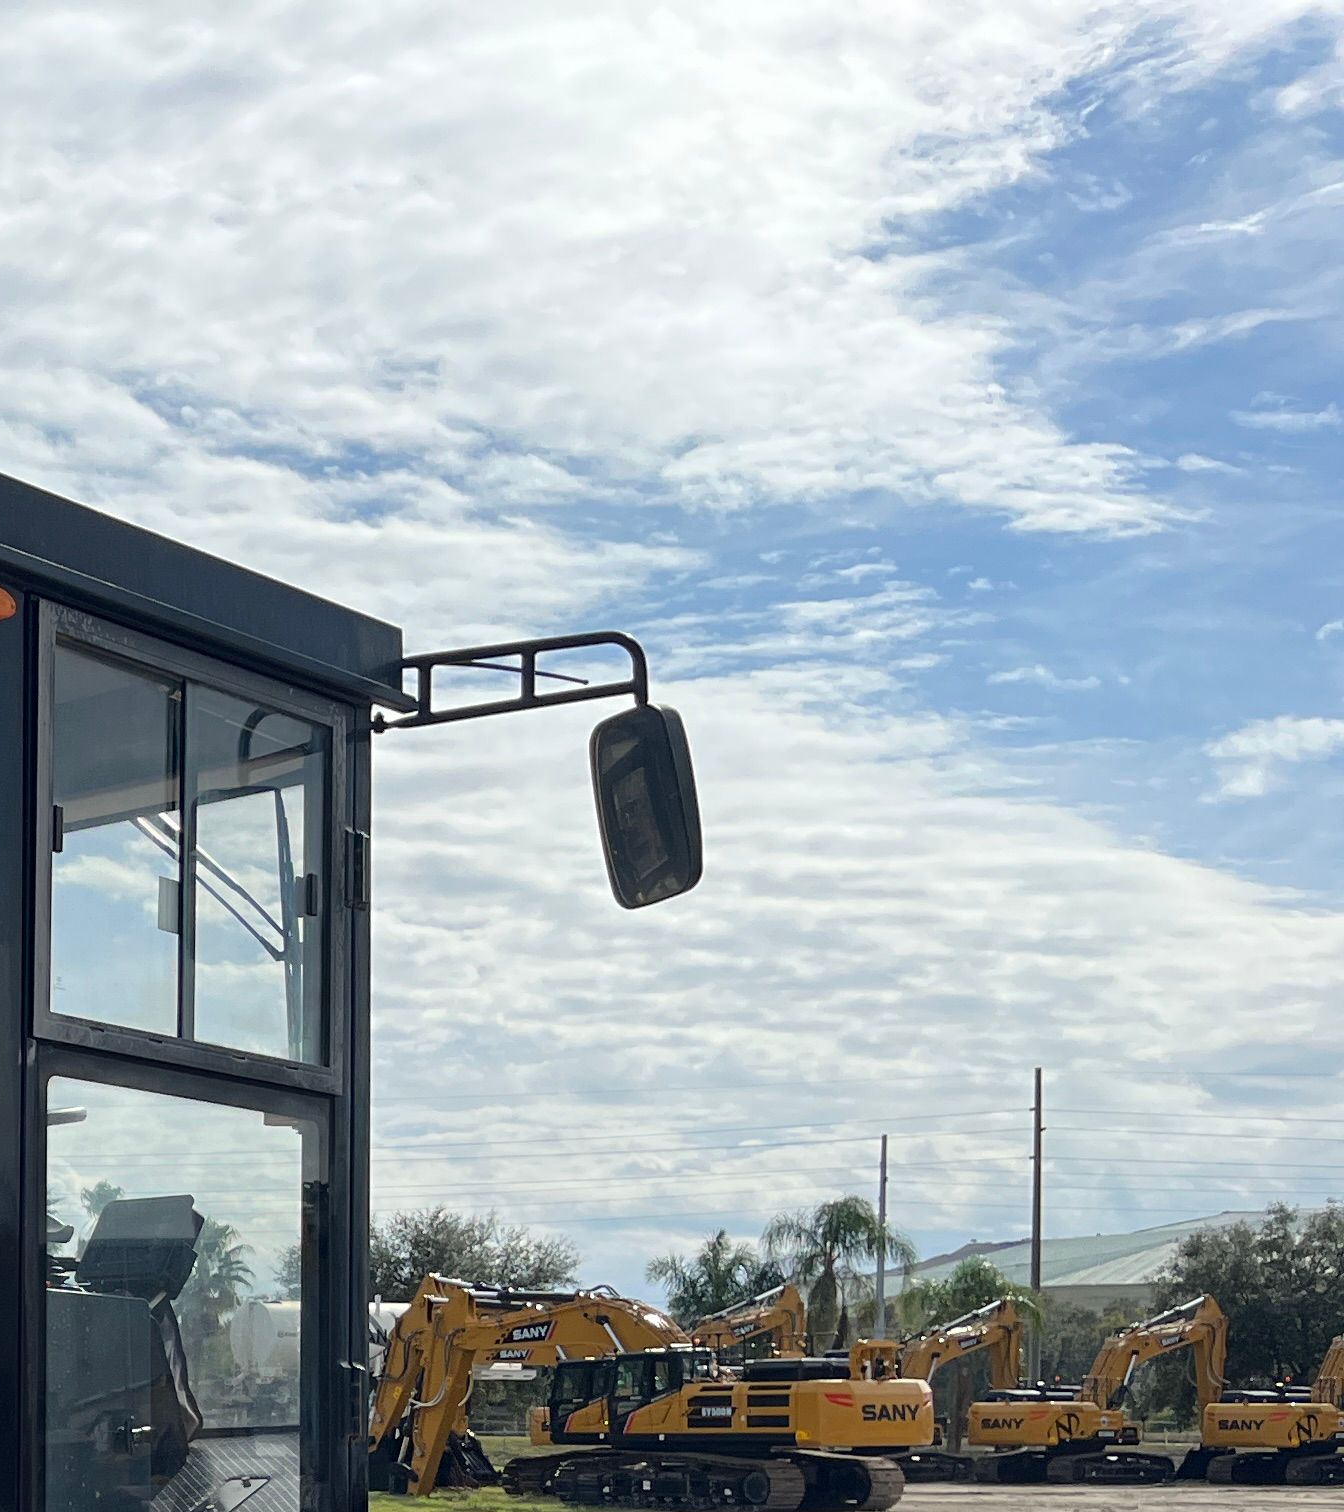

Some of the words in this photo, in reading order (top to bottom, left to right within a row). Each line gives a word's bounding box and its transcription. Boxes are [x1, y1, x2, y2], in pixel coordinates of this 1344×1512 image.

[512, 1325, 548, 1341] SANY
[499, 1349, 528, 1359] SANY
[861, 1404, 920, 1422] SANY
[980, 1418, 1025, 1430] SANY
[1217, 1419, 1265, 1431] SANY
